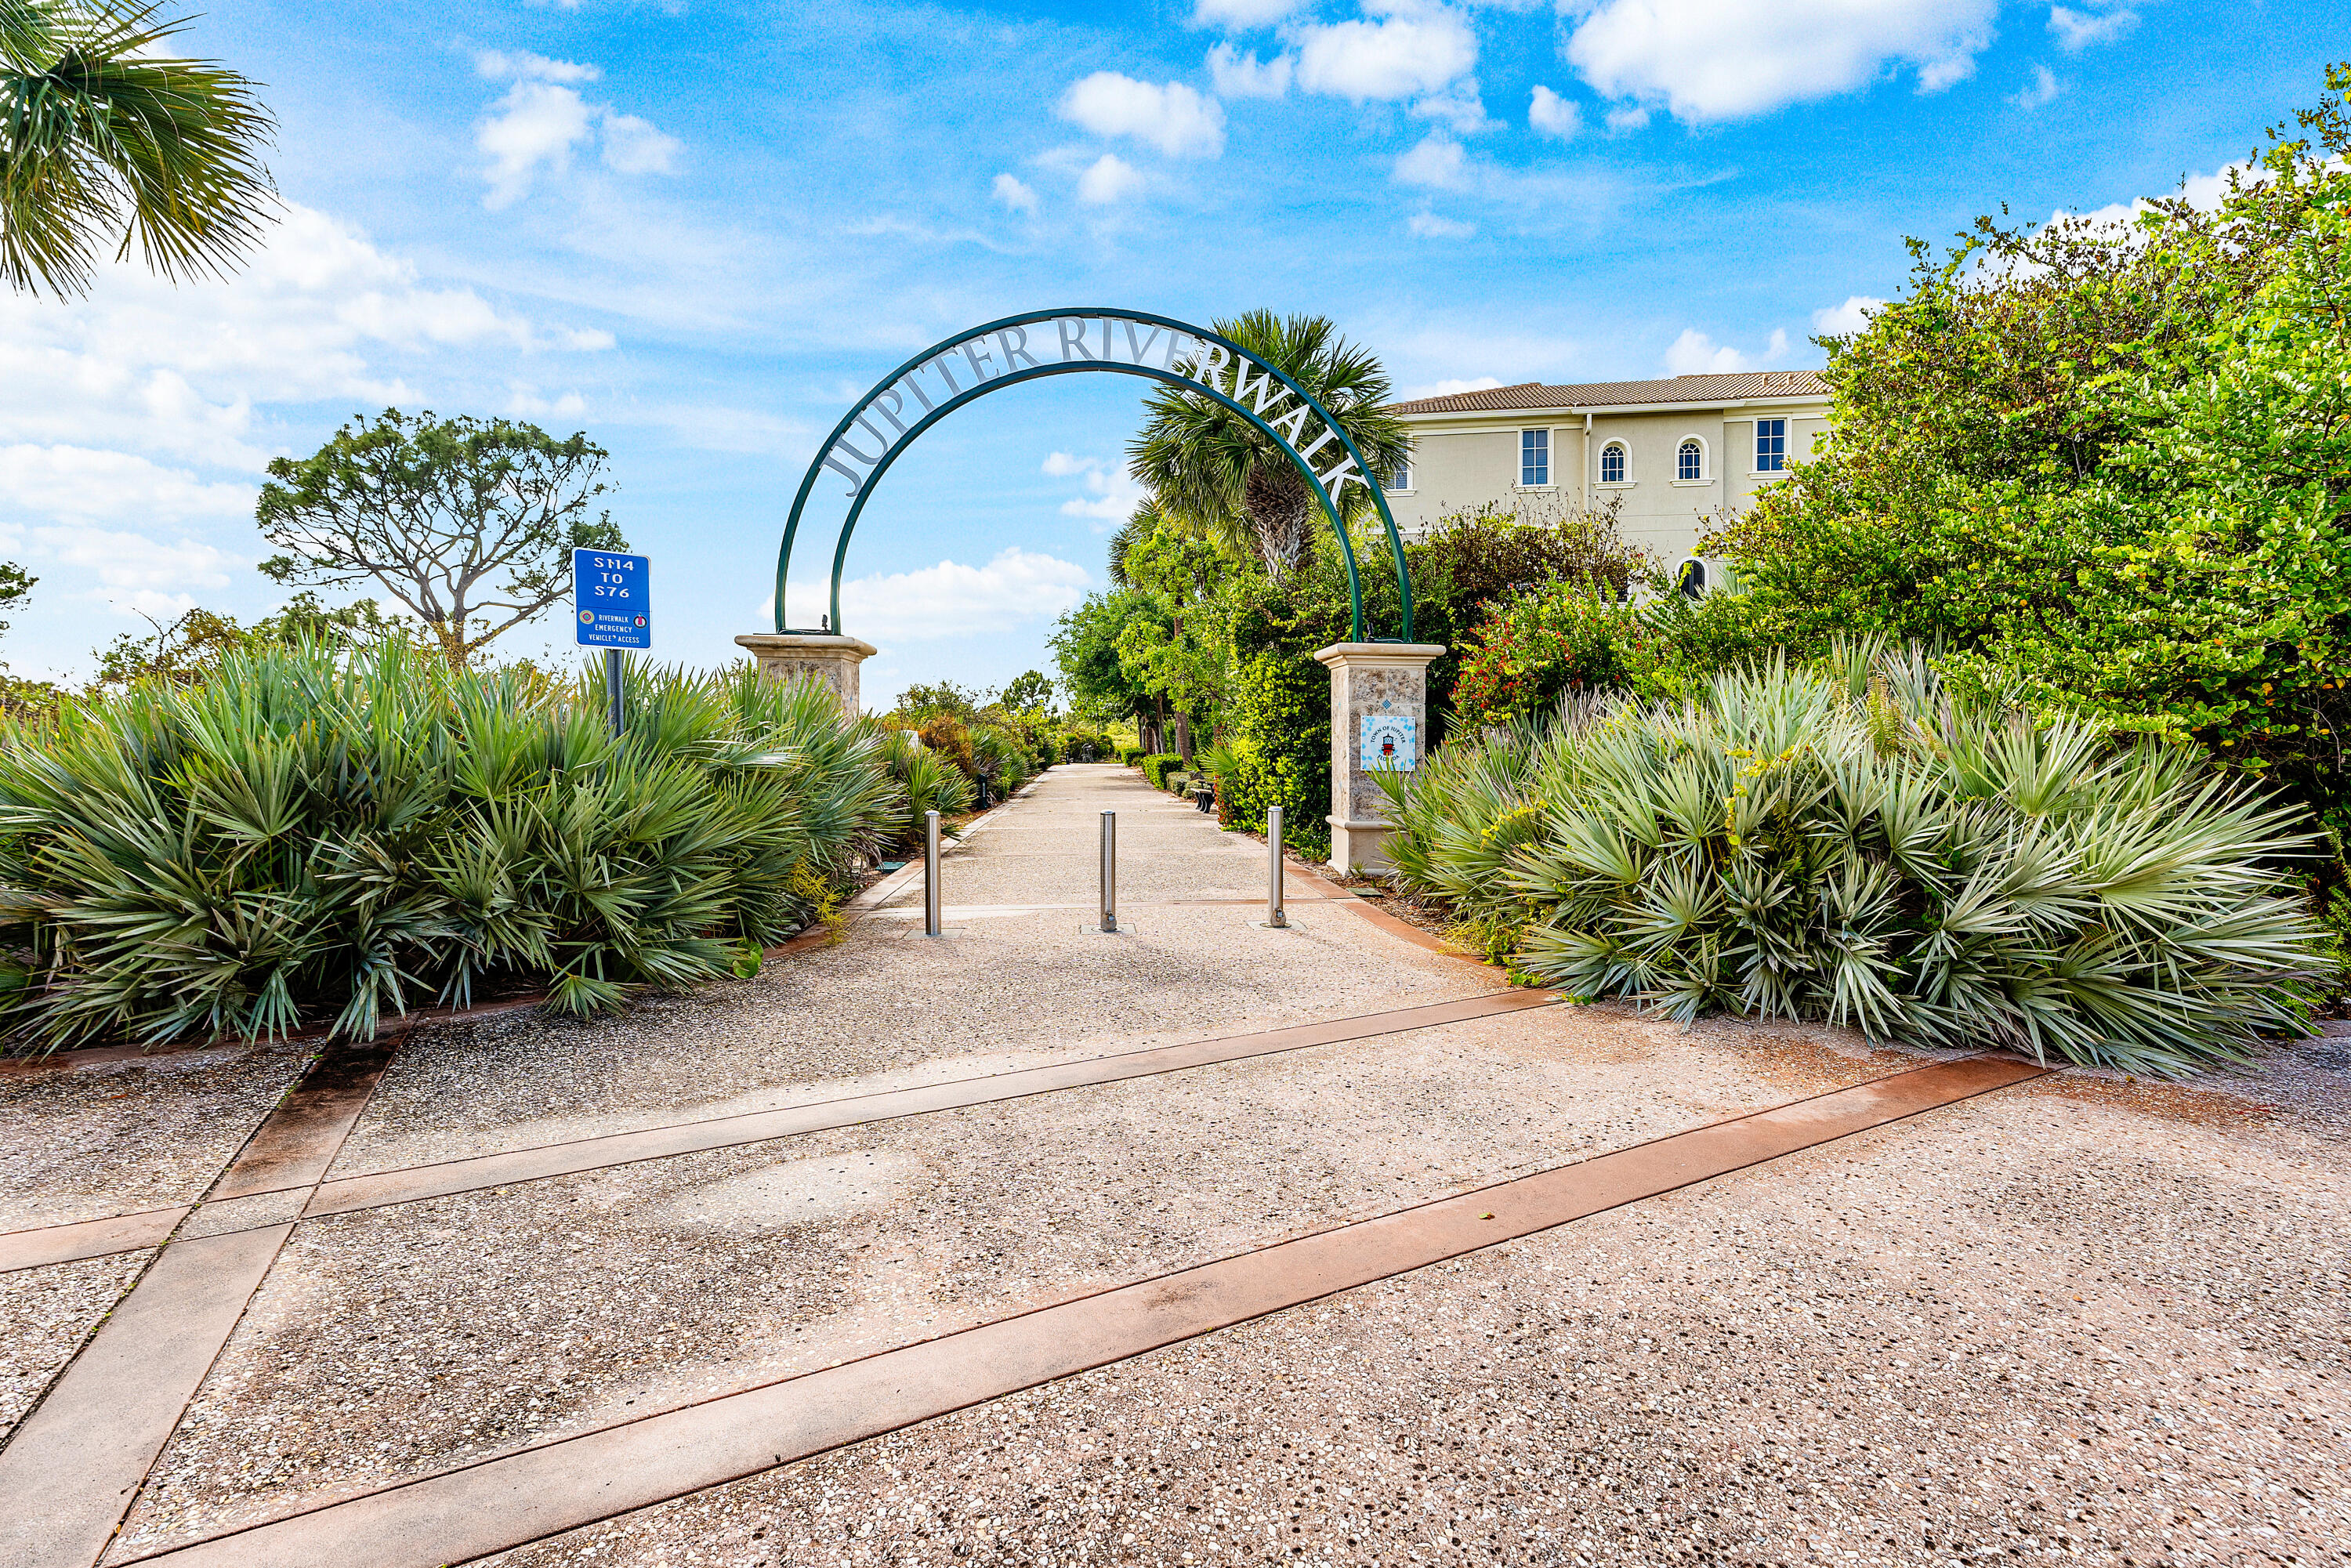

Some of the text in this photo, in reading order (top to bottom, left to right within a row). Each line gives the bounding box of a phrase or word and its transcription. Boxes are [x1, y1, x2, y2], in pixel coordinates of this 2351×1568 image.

[820, 315, 1370, 509] JUPITER RIVERWALK
[594, 557, 633, 570] S114
[600, 572, 623, 584] TO
[594, 585, 629, 598] S76
[1371, 728, 1382, 743] TOWN
[1390, 726, 1406, 744] JUPITER
